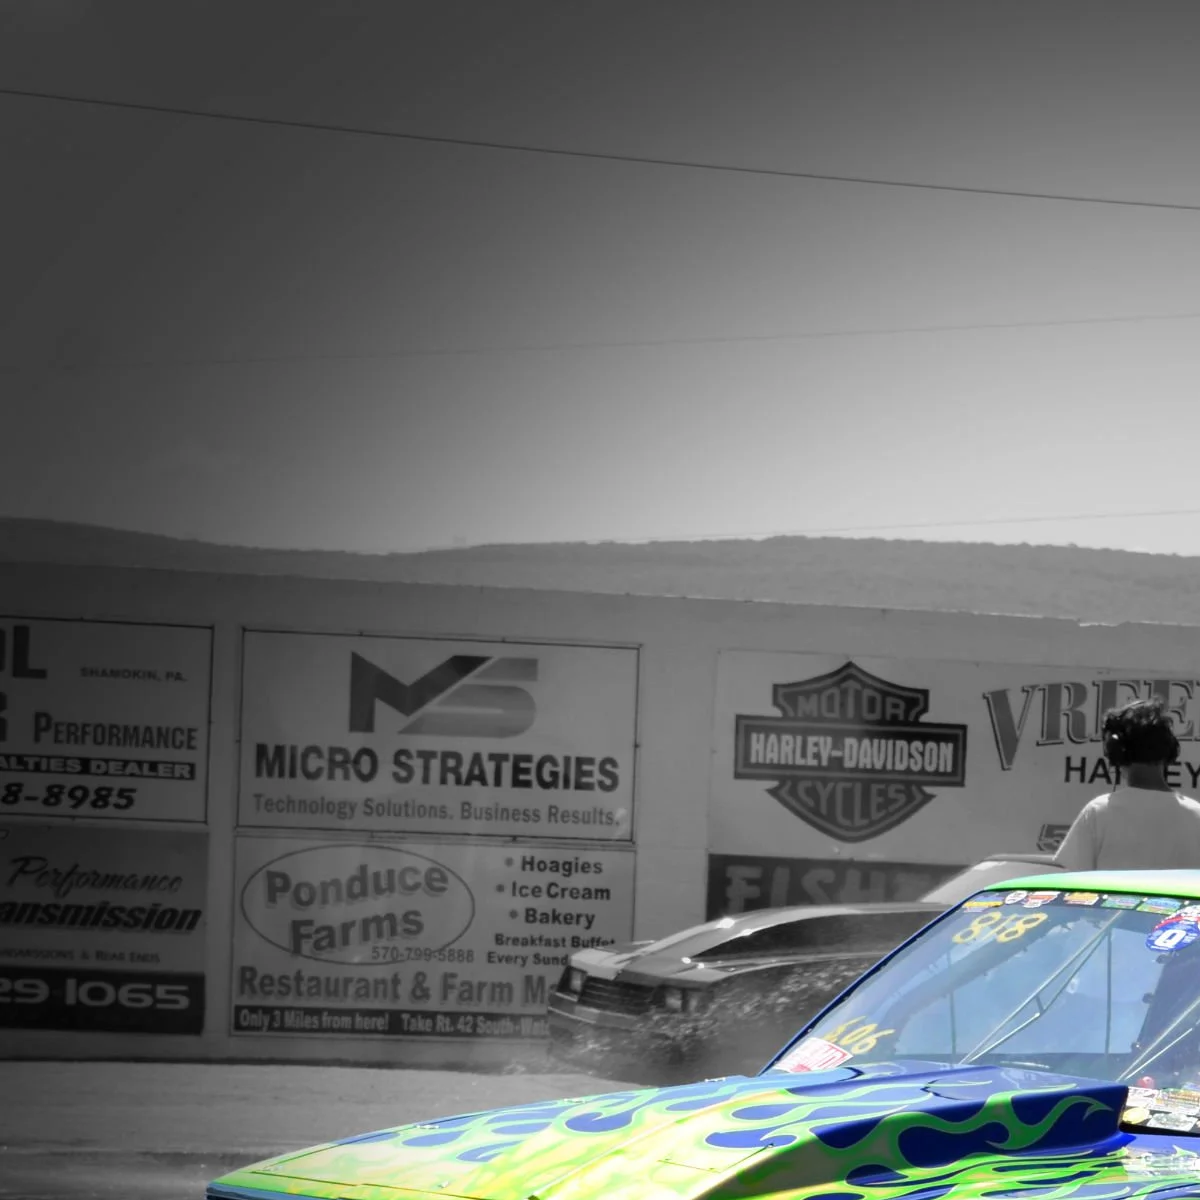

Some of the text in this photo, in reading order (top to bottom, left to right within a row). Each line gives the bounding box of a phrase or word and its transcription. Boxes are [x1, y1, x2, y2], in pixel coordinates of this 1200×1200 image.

[0, 625, 48, 680] L
[797, 679, 905, 721] MOTOR
[33, 711, 199, 751] PERFORMANCE
[90, 759, 192, 779] DEALER
[255, 743, 621, 793] MICRO STRATEGIES
[750, 732, 954, 773] HARLEY-DAVIDSON
[253, 793, 621, 828] Technology Solutions. Business Results.
[796, 779, 907, 828] CYCLES
[6, 855, 184, 899] Performance
[265, 863, 450, 909] Ponduce
[520, 855, 604, 877] Hoagies
[511, 880, 612, 901] Ice Cream
[290, 909, 425, 957] Farms
[524, 907, 596, 931] Bakery
[486, 950, 570, 968] Every Sund
[494, 933, 567, 949] Breakfast
[66, 977, 190, 1010] 1065
[238, 965, 402, 1002] Restaurant
[410, 971, 431, 1004] &
[440, 972, 515, 1006] Farm
[240, 1009, 270, 1032] Only
[273, 1010, 281, 1028] 3
[284, 1011, 319, 1030] Miles
[322, 1011, 352, 1030] from
[354, 1012, 389, 1031] here!
[402, 1013, 433, 1032] Take
